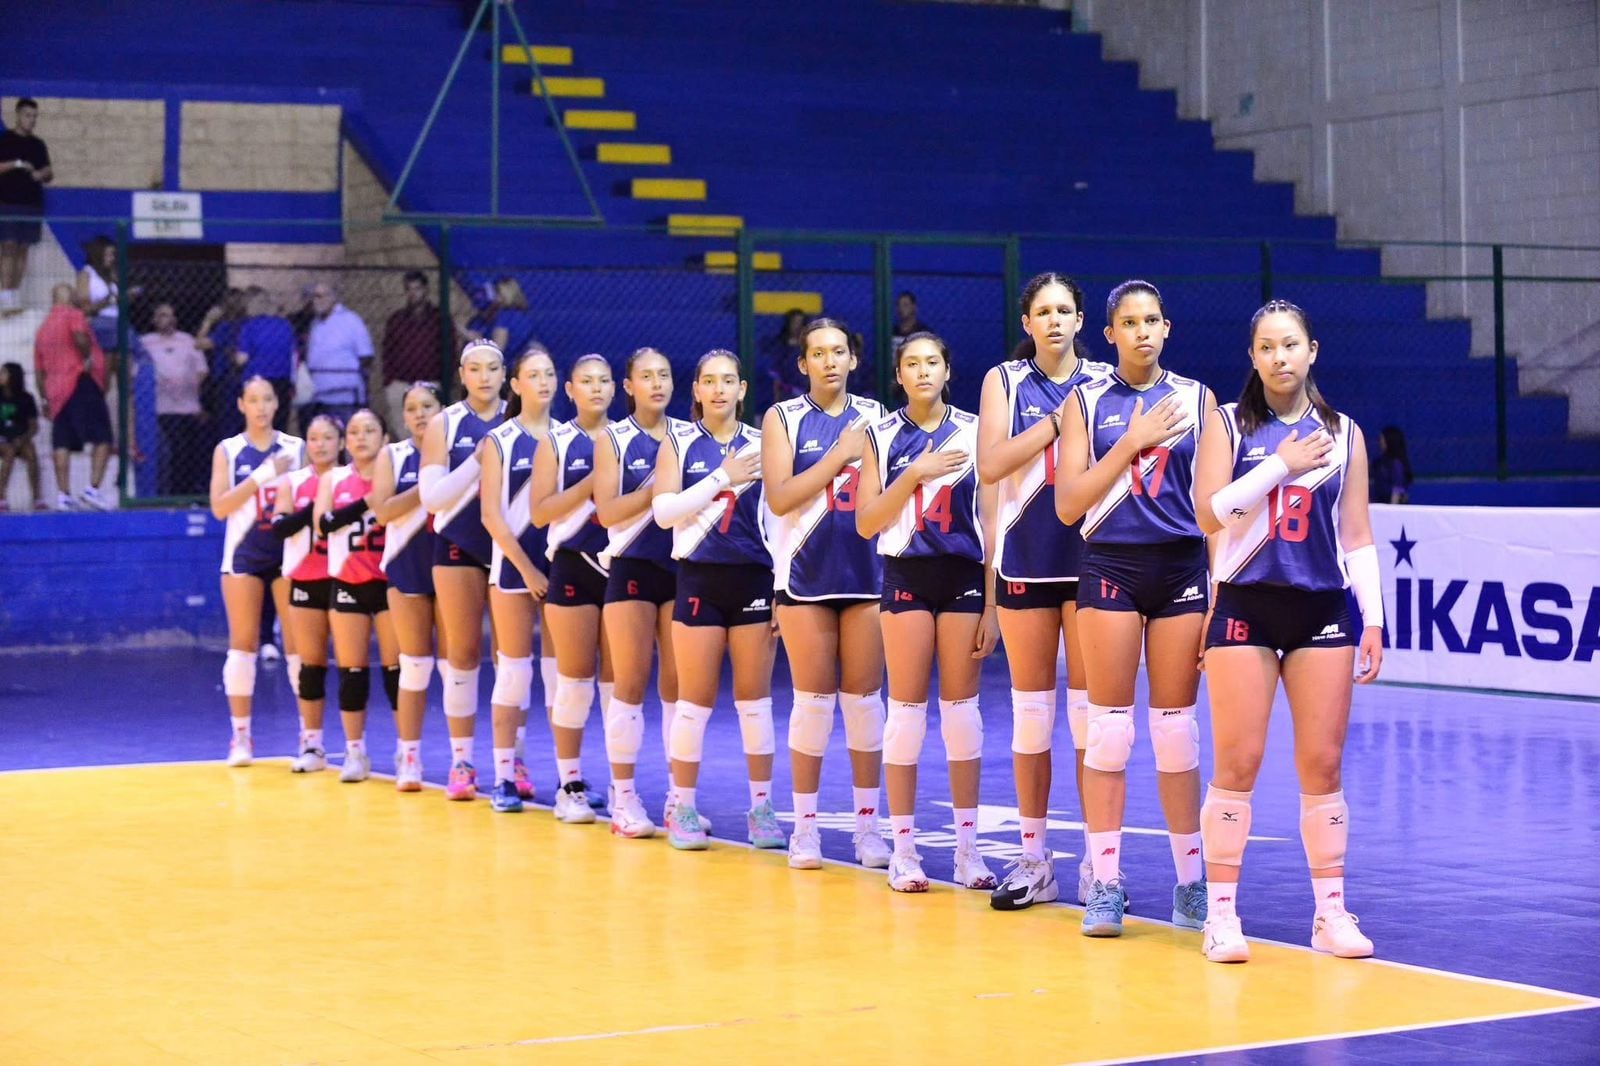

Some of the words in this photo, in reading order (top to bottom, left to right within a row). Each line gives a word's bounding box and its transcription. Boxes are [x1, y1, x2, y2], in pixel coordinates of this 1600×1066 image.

[825, 465, 860, 512] 13
[1130, 446, 1170, 498] 17
[713, 490, 738, 534] 7
[914, 482, 953, 534] 14
[1267, 484, 1313, 542] 18
[626, 580, 639, 595] 6
[688, 597, 700, 616] 7
[1225, 617, 1250, 641] 18
